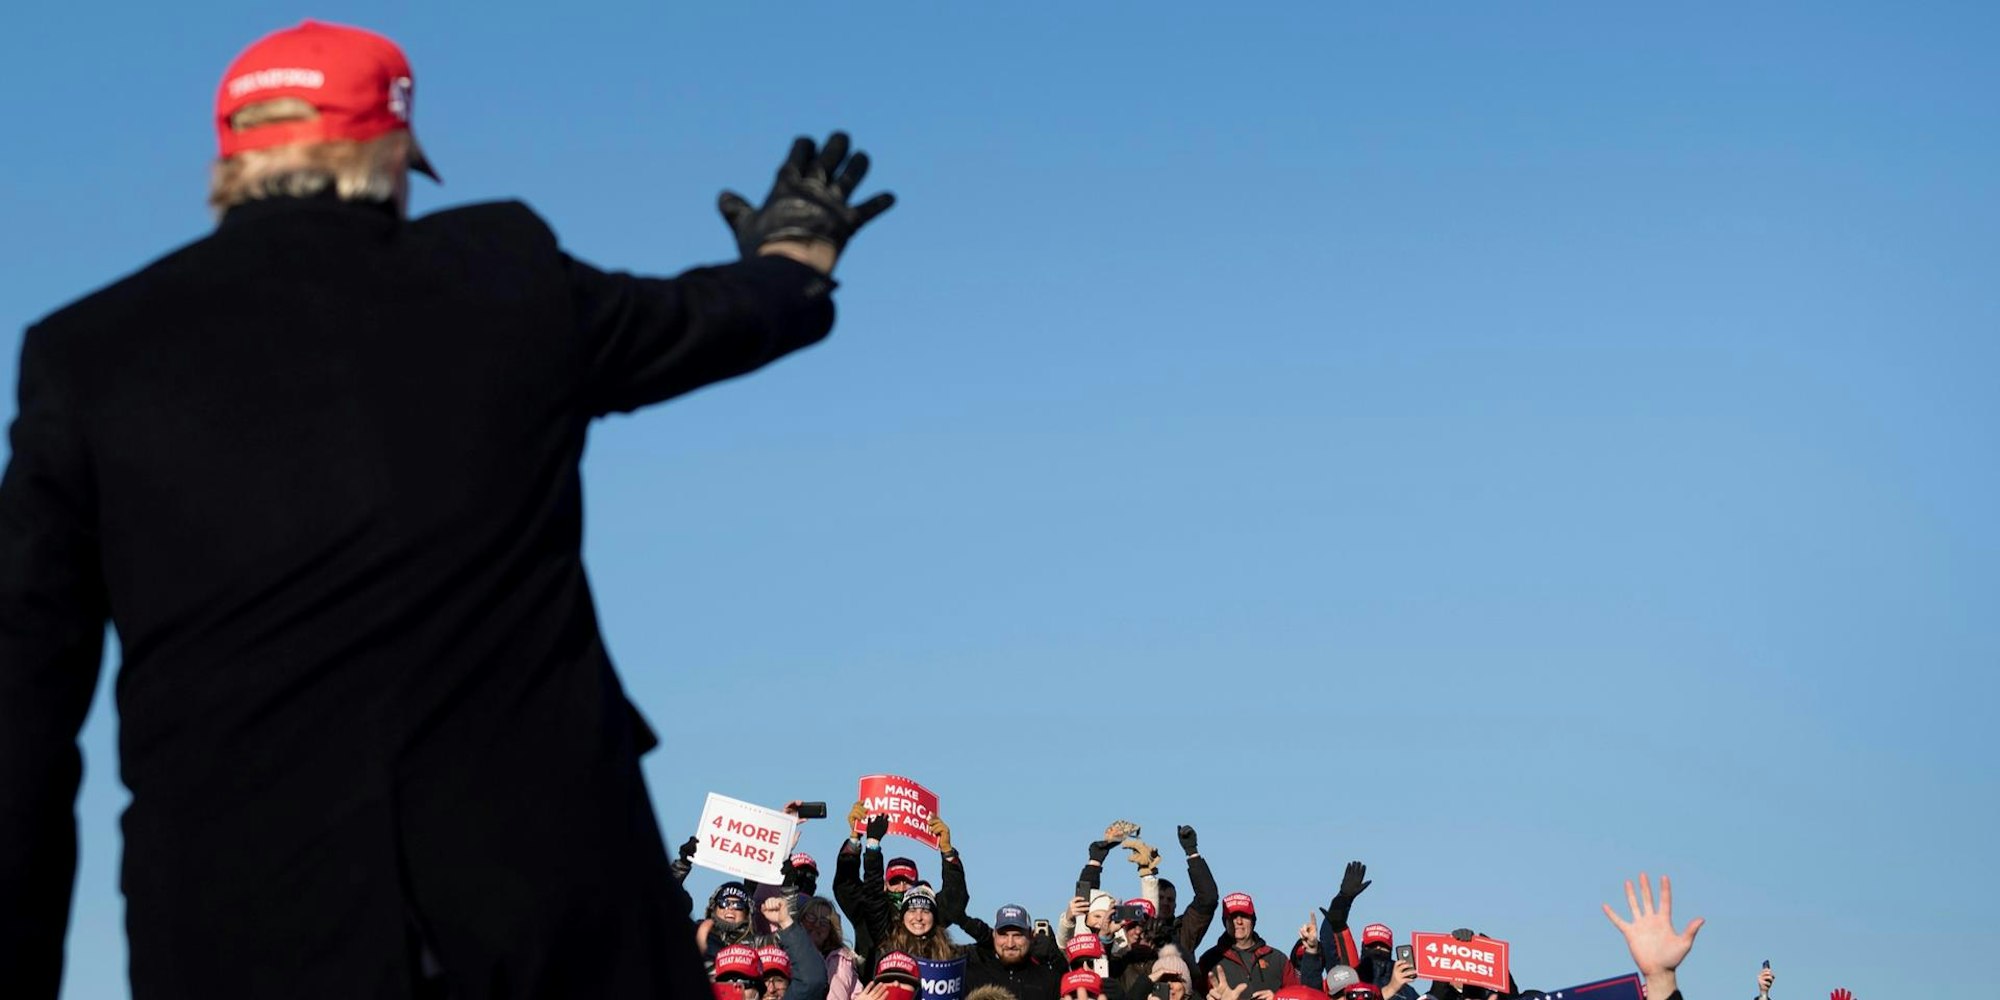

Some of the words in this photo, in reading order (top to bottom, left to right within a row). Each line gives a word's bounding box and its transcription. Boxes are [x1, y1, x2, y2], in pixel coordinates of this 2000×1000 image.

[885, 784, 919, 801] MAKE
[712, 815, 723, 829] 4
[727, 818, 781, 845] MORE
[710, 834, 775, 864] YEARS!
[1425, 942, 1438, 953] 4
[1442, 943, 1495, 964] MORE
[1427, 955, 1494, 978] YEARS!
[921, 977, 961, 995] MORE
